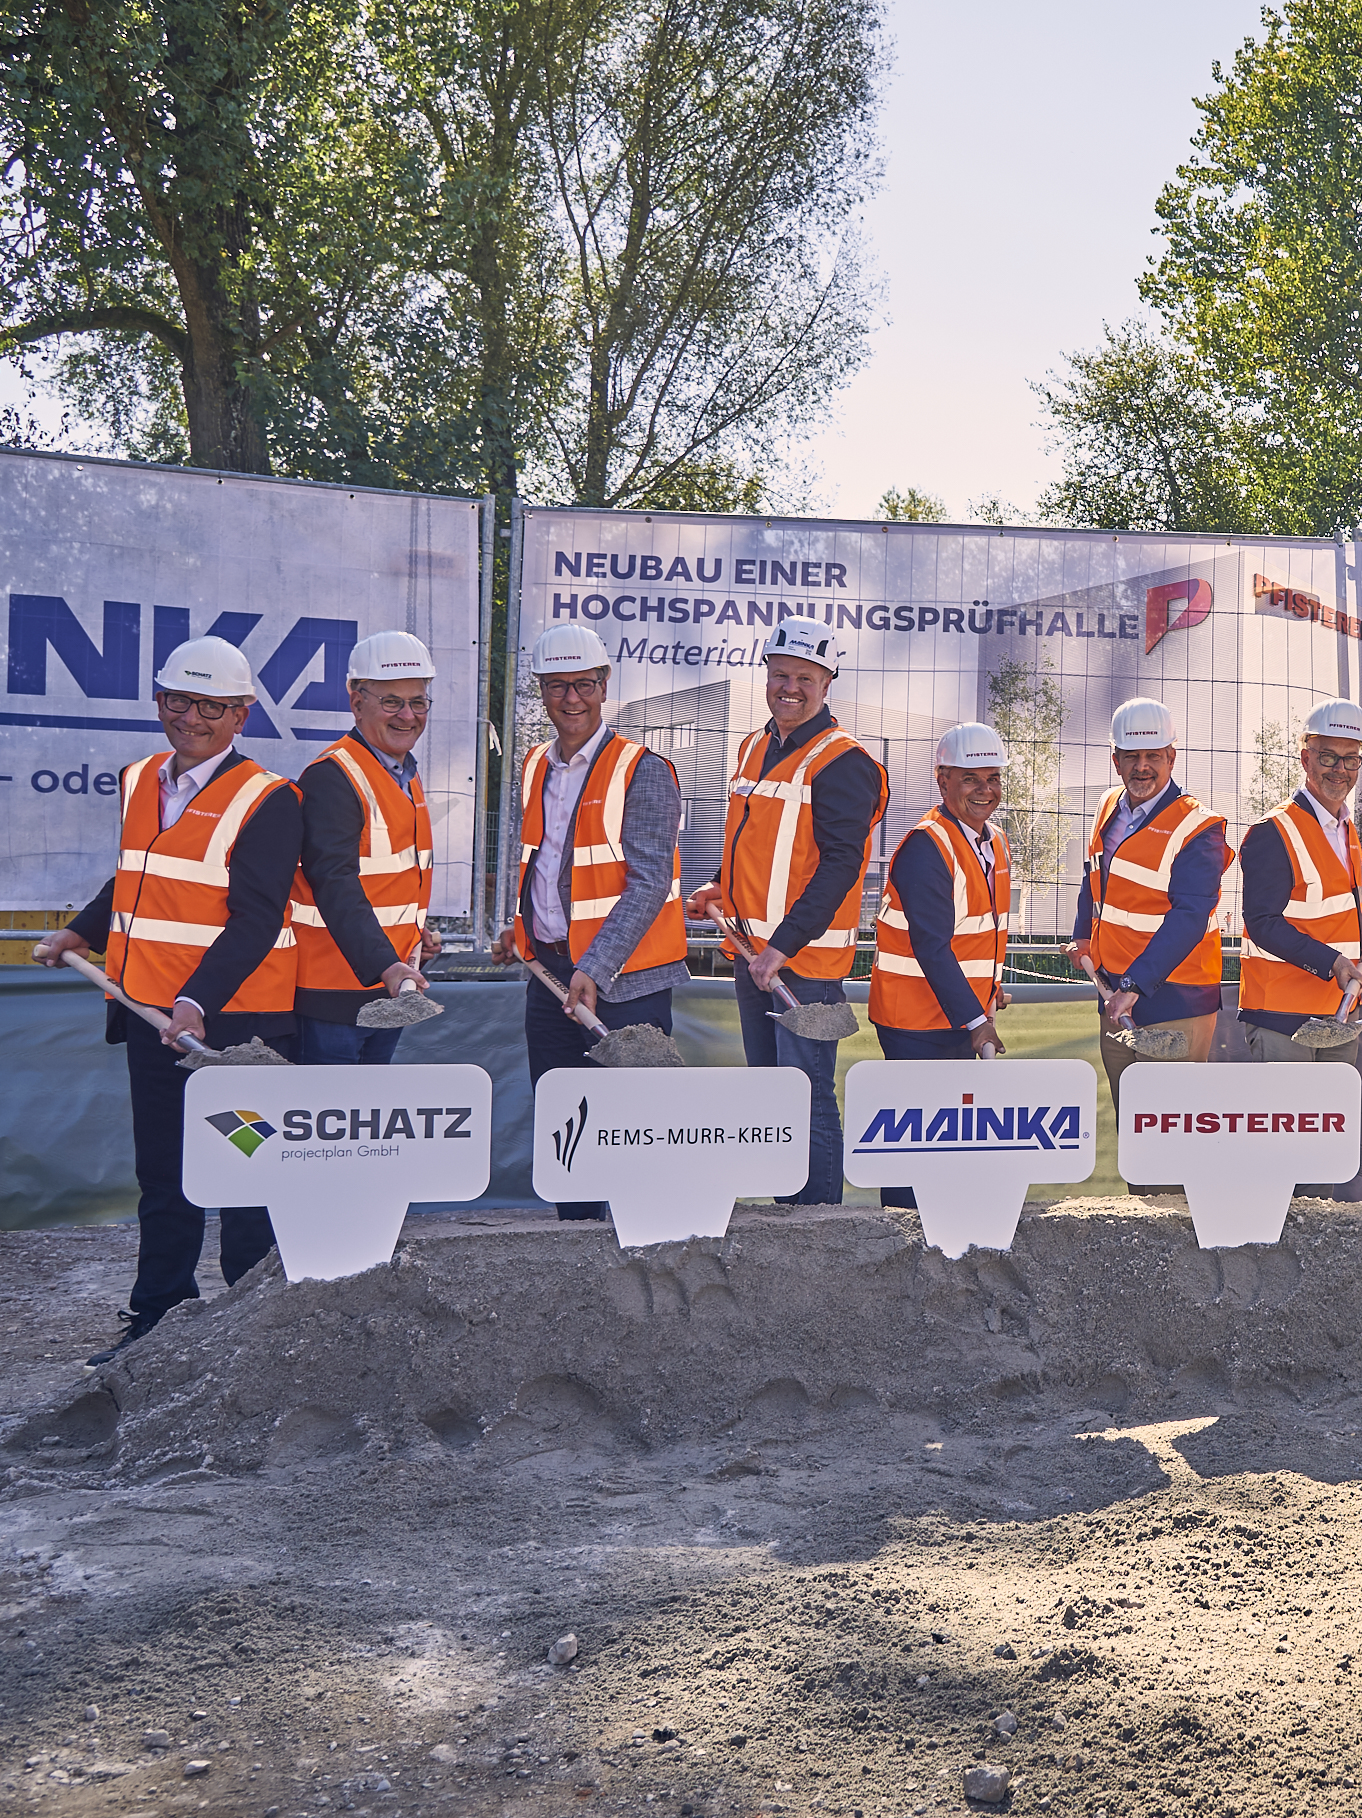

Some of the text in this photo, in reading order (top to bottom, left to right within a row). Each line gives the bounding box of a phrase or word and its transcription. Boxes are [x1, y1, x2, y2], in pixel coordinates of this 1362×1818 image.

[555, 551, 847, 588] NEUBAU EINER
[552, 592, 1139, 639] HOCHSPANNUNGSPRÜFHALLE
[1329, 722, 1361, 731] PFISTERER
[31, 763, 117, 796] ode
[282, 1107, 472, 1141] SCHATZ
[597, 1126, 793, 1146] REMS-MURR-KREIS
[1134, 1112, 1346, 1133] PFISTERER
[281, 1144, 399, 1162] projectplan GmbH
